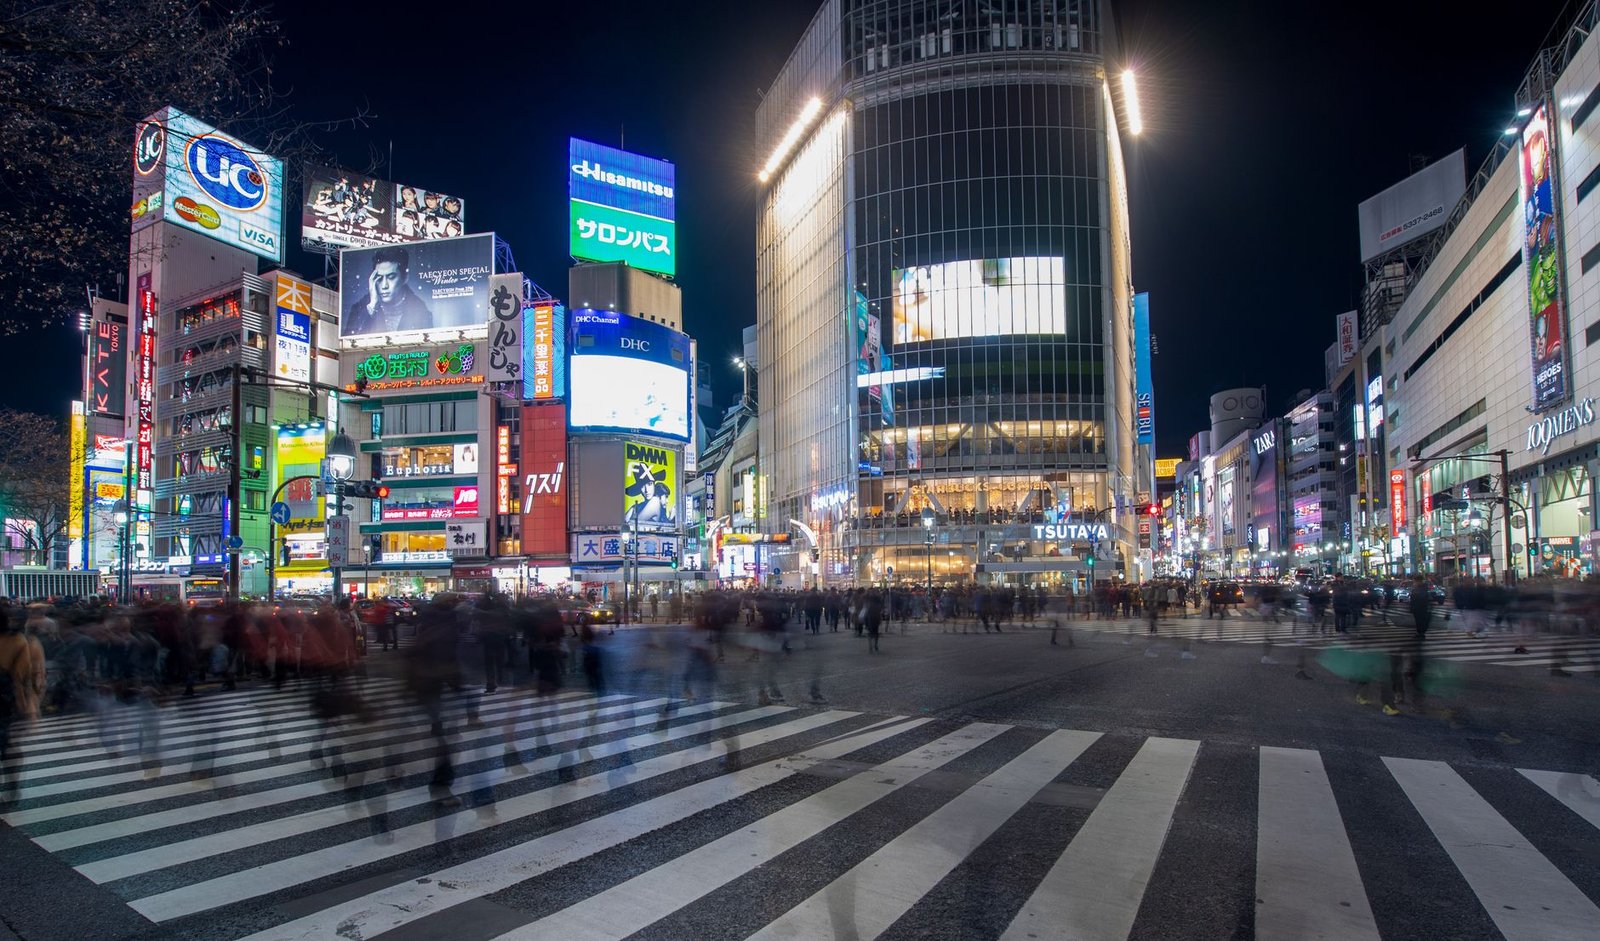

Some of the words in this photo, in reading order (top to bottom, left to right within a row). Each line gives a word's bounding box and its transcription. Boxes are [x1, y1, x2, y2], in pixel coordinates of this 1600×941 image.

[138, 131, 161, 163] UC
[196, 144, 261, 199] UC
[572, 160, 673, 198] Hisamitsu
[174, 201, 220, 224] MasterCard
[244, 229, 275, 248] VISA
[577, 218, 670, 255] サロンパス
[419, 269, 458, 279] TAECYEON
[460, 266, 489, 276] SPECIAL
[491, 285, 521, 378] もんじゃ
[620, 338, 650, 351] DHC
[97, 322, 110, 412] KATE
[111, 325, 119, 352] TOKYO
[388, 360, 428, 378] 西村
[1138, 393, 1151, 434] SEIBU
[627, 444, 668, 466] DMM
[386, 464, 451, 477] Euphoria
[627, 462, 655, 481] FX
[456, 489, 477, 504] JTB
[912, 482, 989, 495] STARBUCKS
[1034, 525, 1107, 539] TSUTAYA
